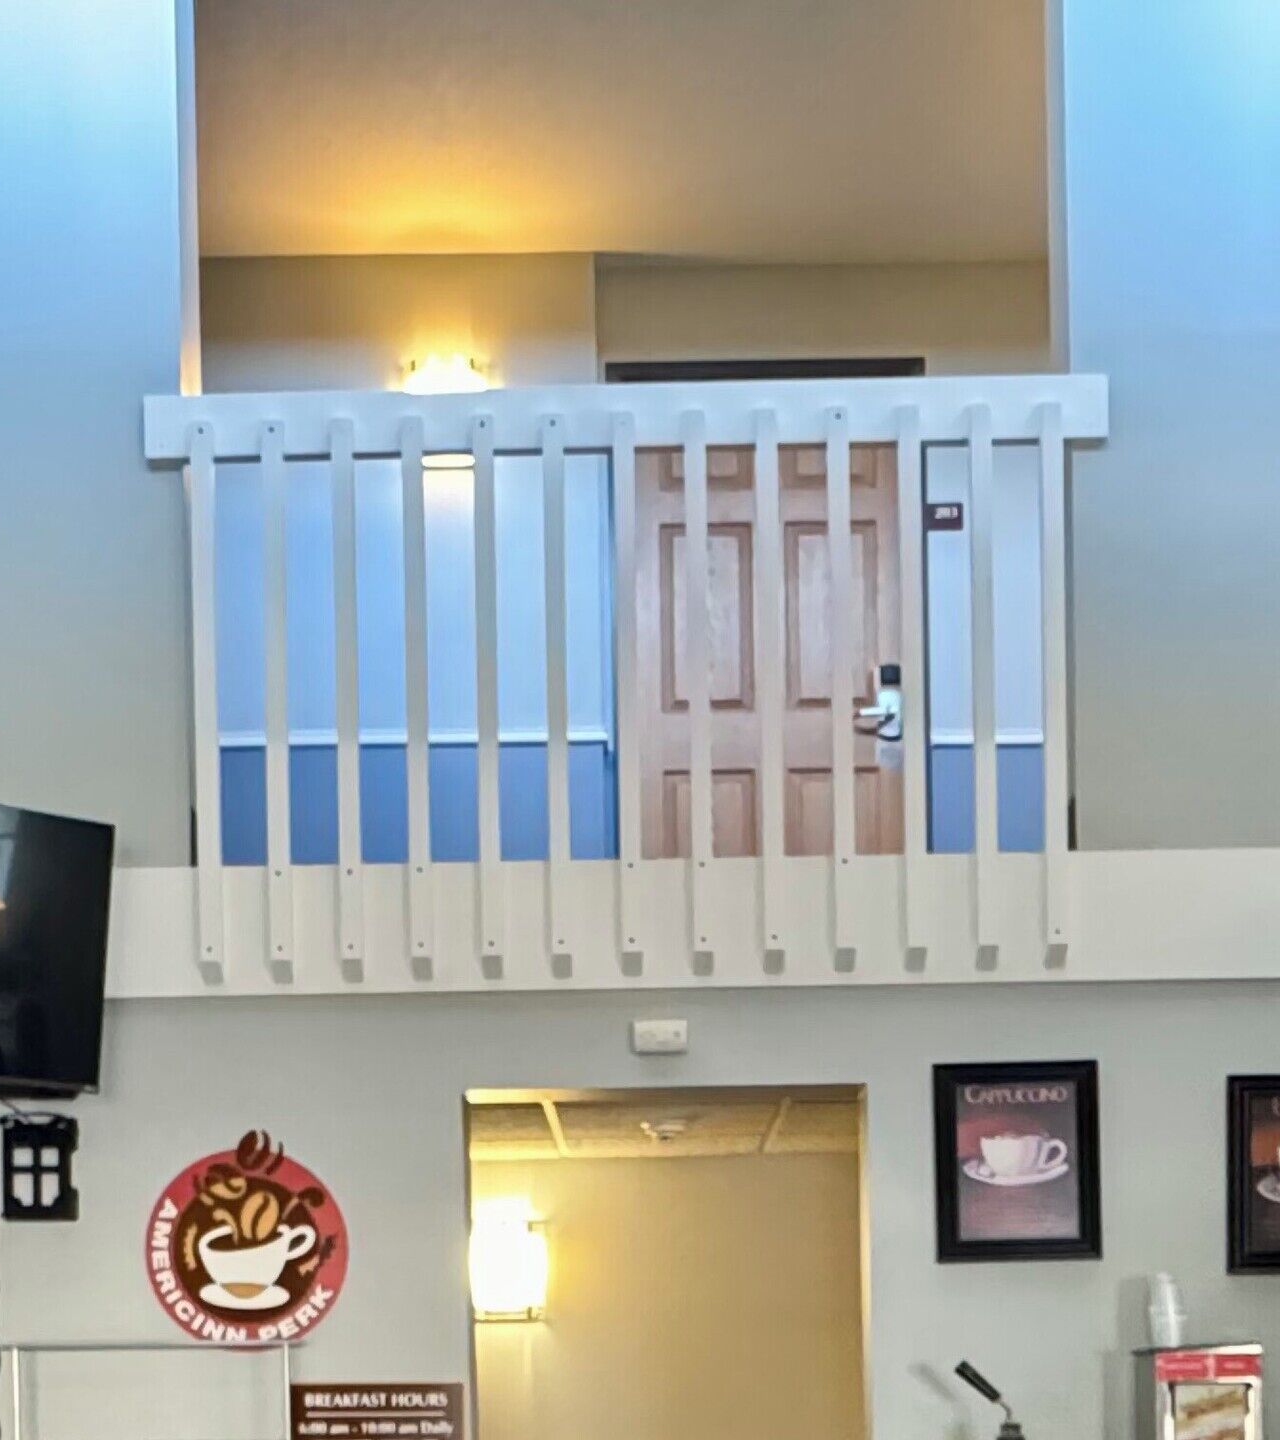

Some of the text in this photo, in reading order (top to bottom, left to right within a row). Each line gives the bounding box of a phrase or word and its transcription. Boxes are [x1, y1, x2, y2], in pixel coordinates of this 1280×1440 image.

[151, 1198, 334, 1342] AMERICINN PERK
[304, 1392, 448, 1408] BREAKFAST HOURS
[421, 1420, 454, 1437] Daily
